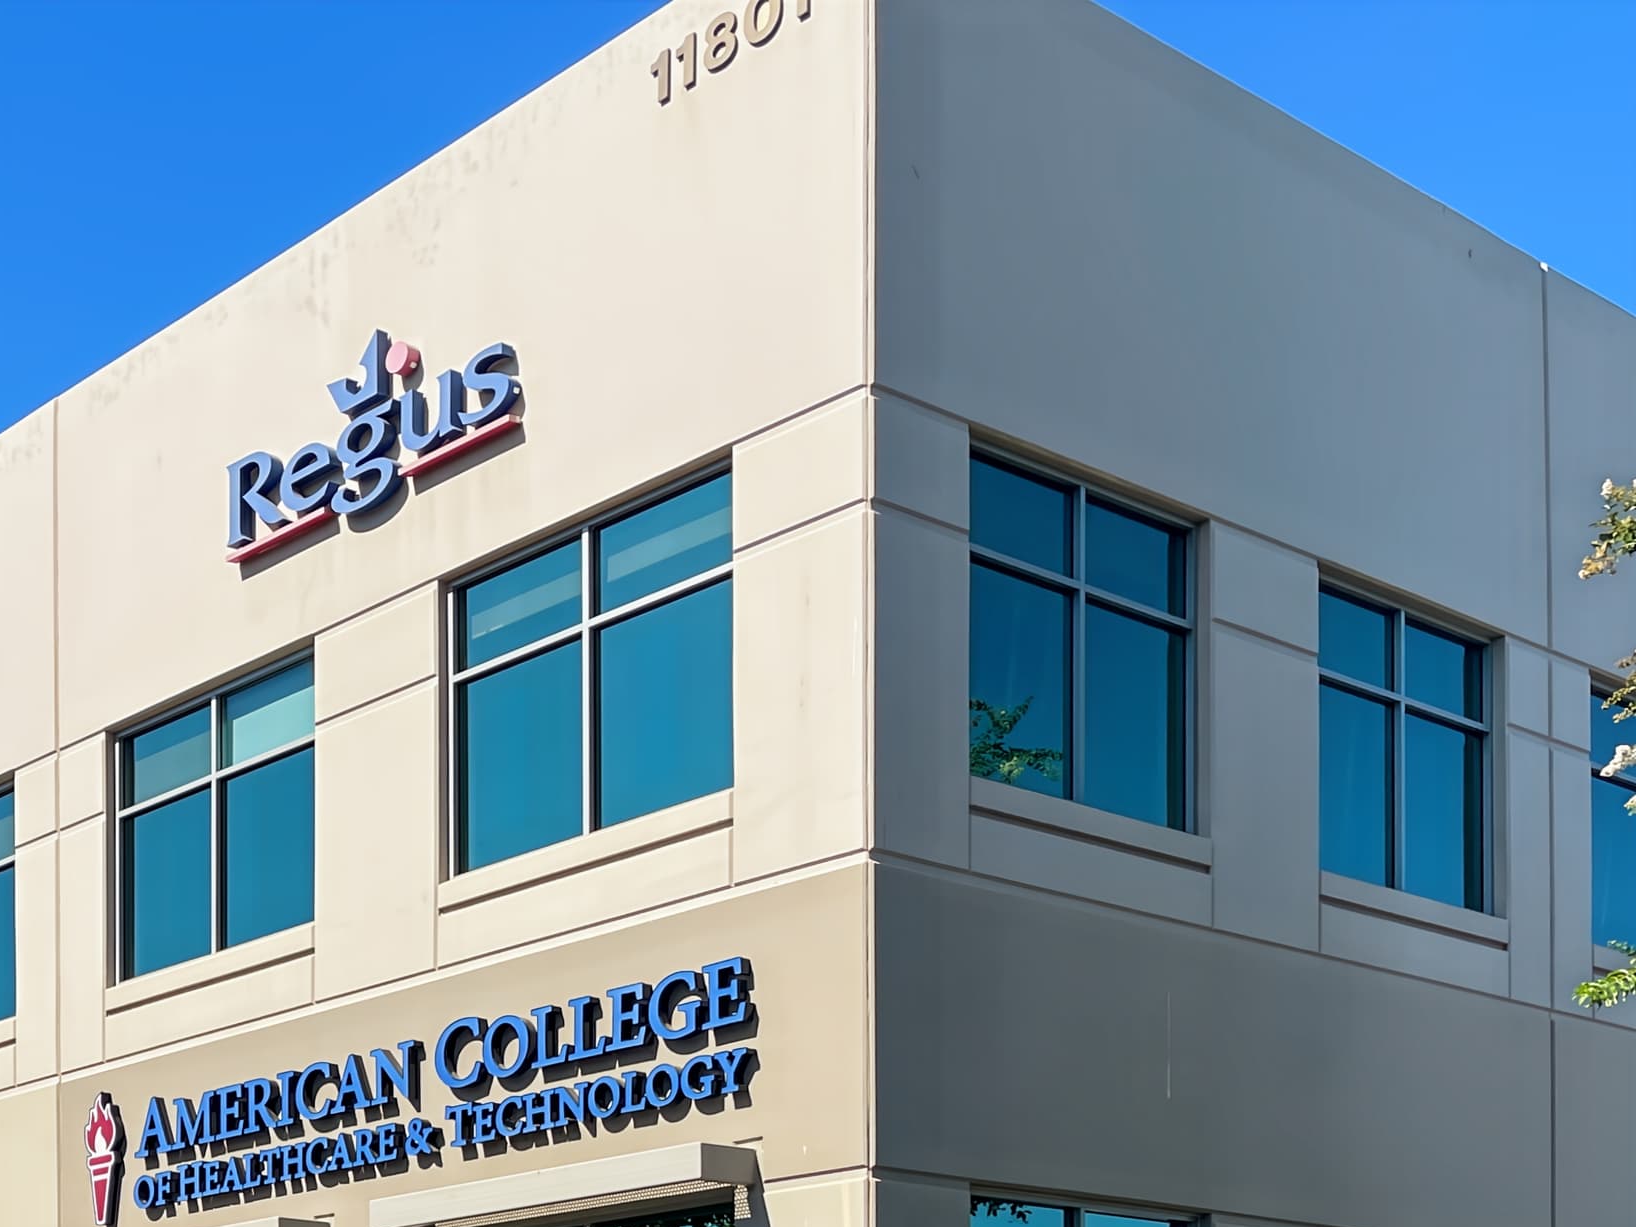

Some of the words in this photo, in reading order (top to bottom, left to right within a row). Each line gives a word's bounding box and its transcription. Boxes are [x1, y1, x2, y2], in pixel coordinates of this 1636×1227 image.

[225, 332, 520, 549] Regus
[133, 1174, 177, 1209] OF
[177, 1123, 403, 1202] HEALTHCARE
[405, 1117, 438, 1156] &
[445, 1047, 754, 1147] TECHNOLOGY
[134, 1039, 426, 1159] AMERICAN
[434, 956, 754, 1089] COLLEGE
